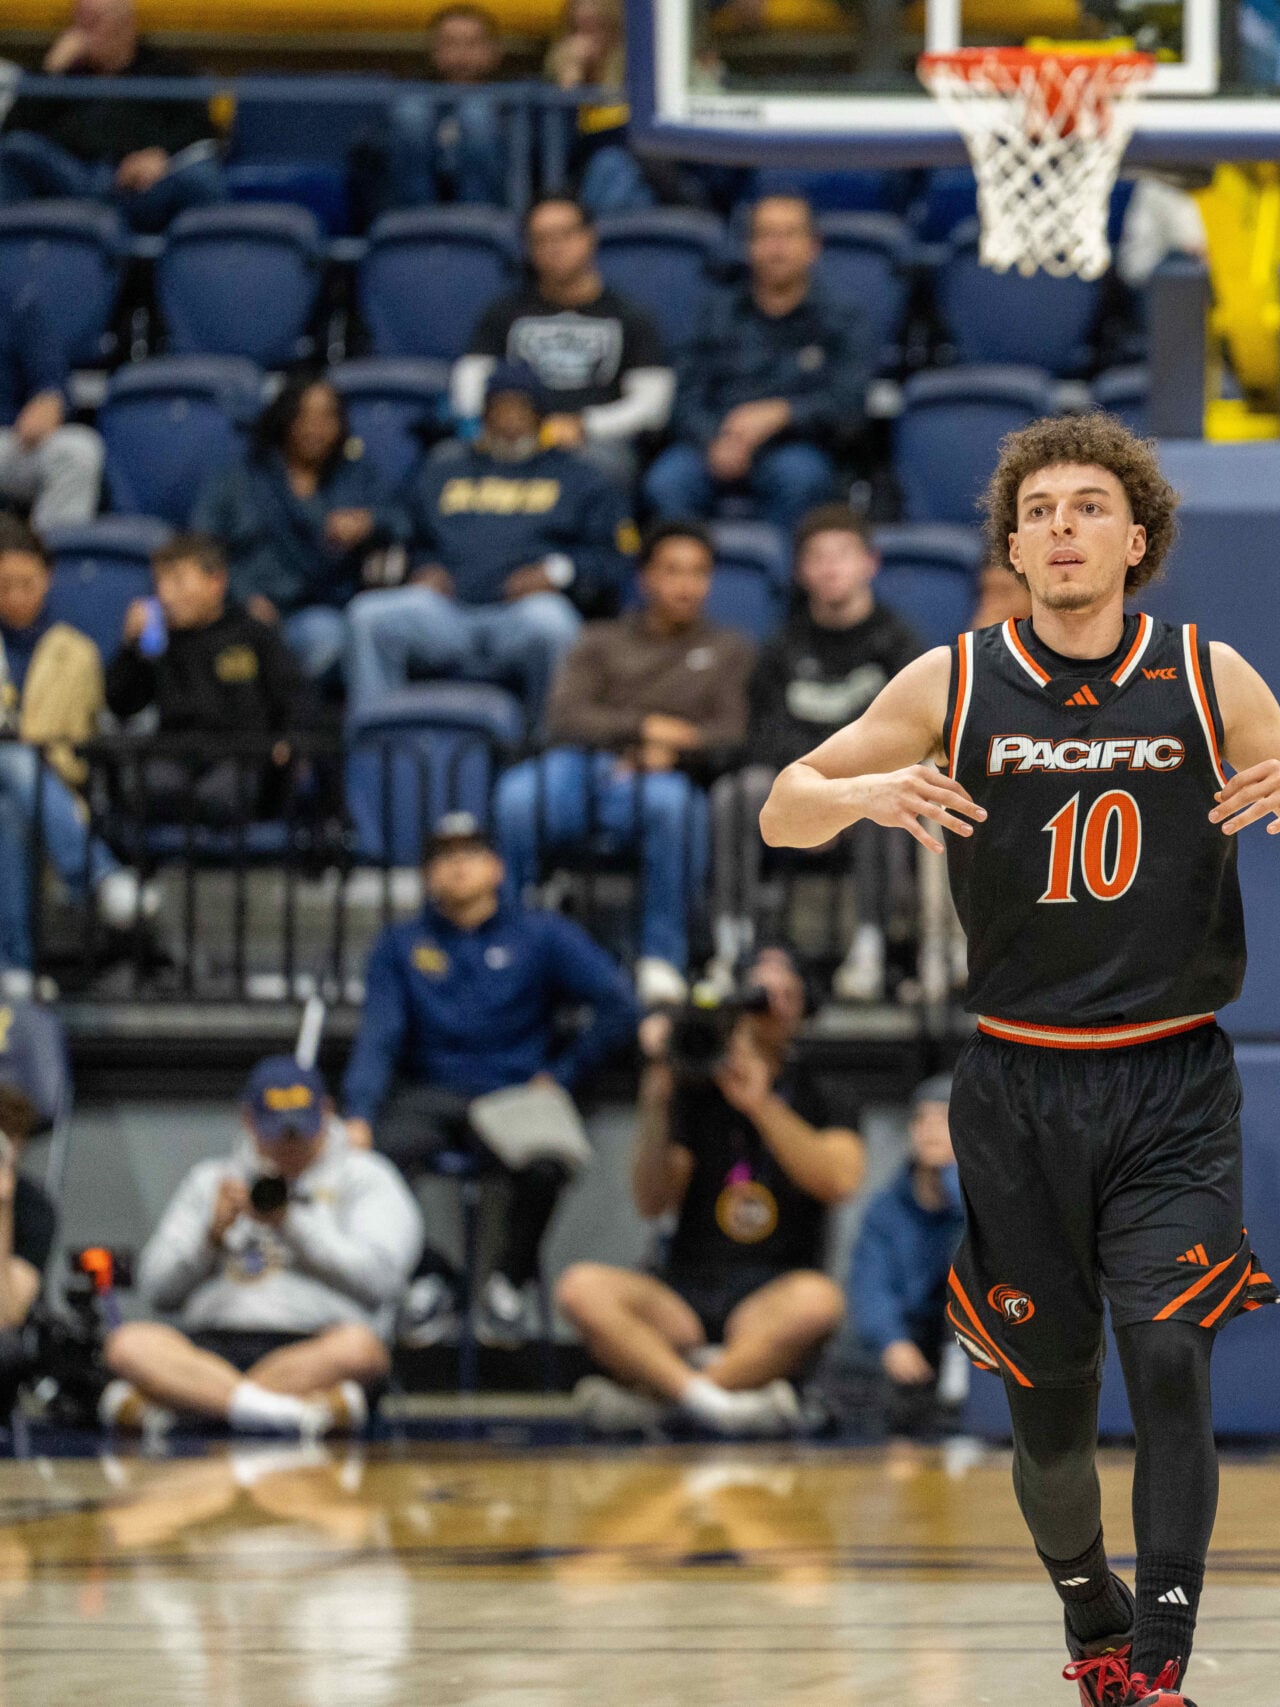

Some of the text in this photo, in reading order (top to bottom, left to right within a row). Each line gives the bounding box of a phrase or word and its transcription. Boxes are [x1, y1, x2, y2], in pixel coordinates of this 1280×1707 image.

[1141, 667, 1178, 680] WCC
[986, 734, 1185, 776] PACIFIC
[1036, 789, 1142, 903] 10
